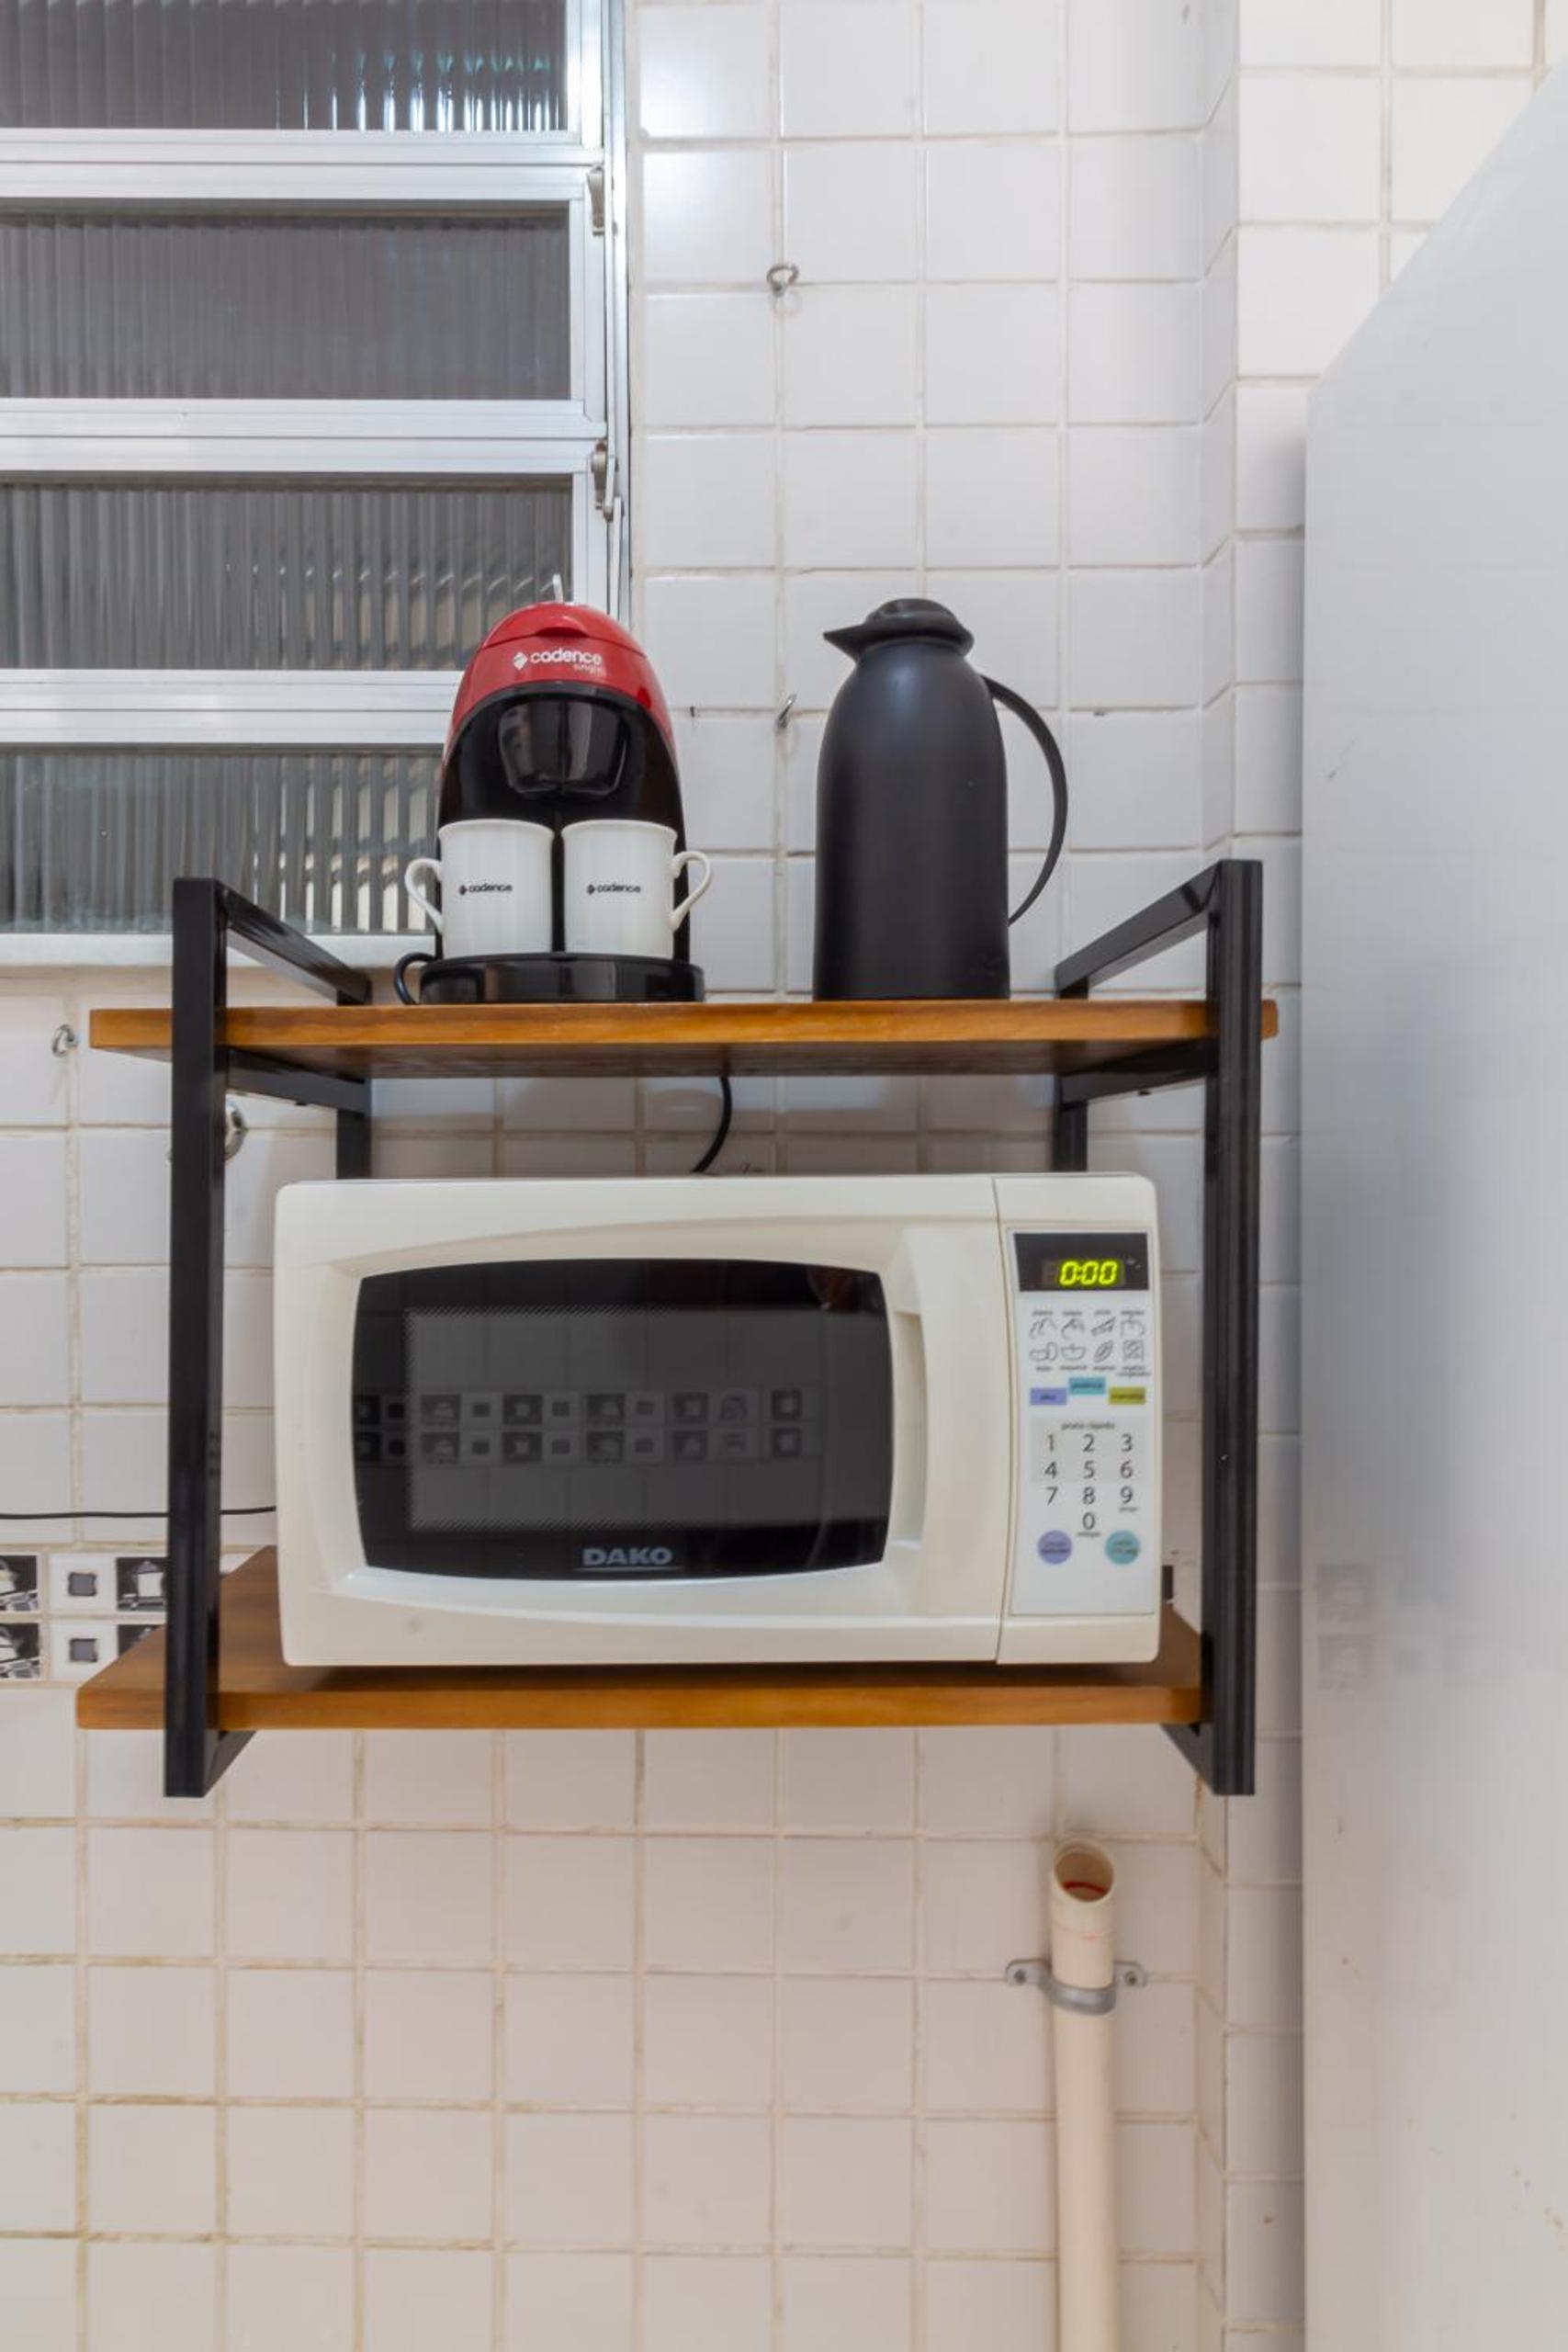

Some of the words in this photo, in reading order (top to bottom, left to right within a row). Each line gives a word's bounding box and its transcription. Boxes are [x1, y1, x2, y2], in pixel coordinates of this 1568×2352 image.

[530, 648, 603, 665] cadence
[468, 883, 513, 893] cadence
[597, 884, 641, 894] cadence
[1059, 1261, 1118, 1285] 0:00
[1047, 1433, 1055, 1453] 1
[1082, 1433, 1095, 1453] 2
[1121, 1433, 1133, 1453] 3
[1044, 1460, 1057, 1479] 4
[1083, 1460, 1095, 1479] 5
[1120, 1459, 1134, 1479] 6
[1045, 1487, 1058, 1506] 7
[1082, 1486, 1096, 1505] 8
[1120, 1485, 1134, 1505] 9
[1082, 1511, 1096, 1531] 0
[582, 1547, 672, 1566] DAKO
